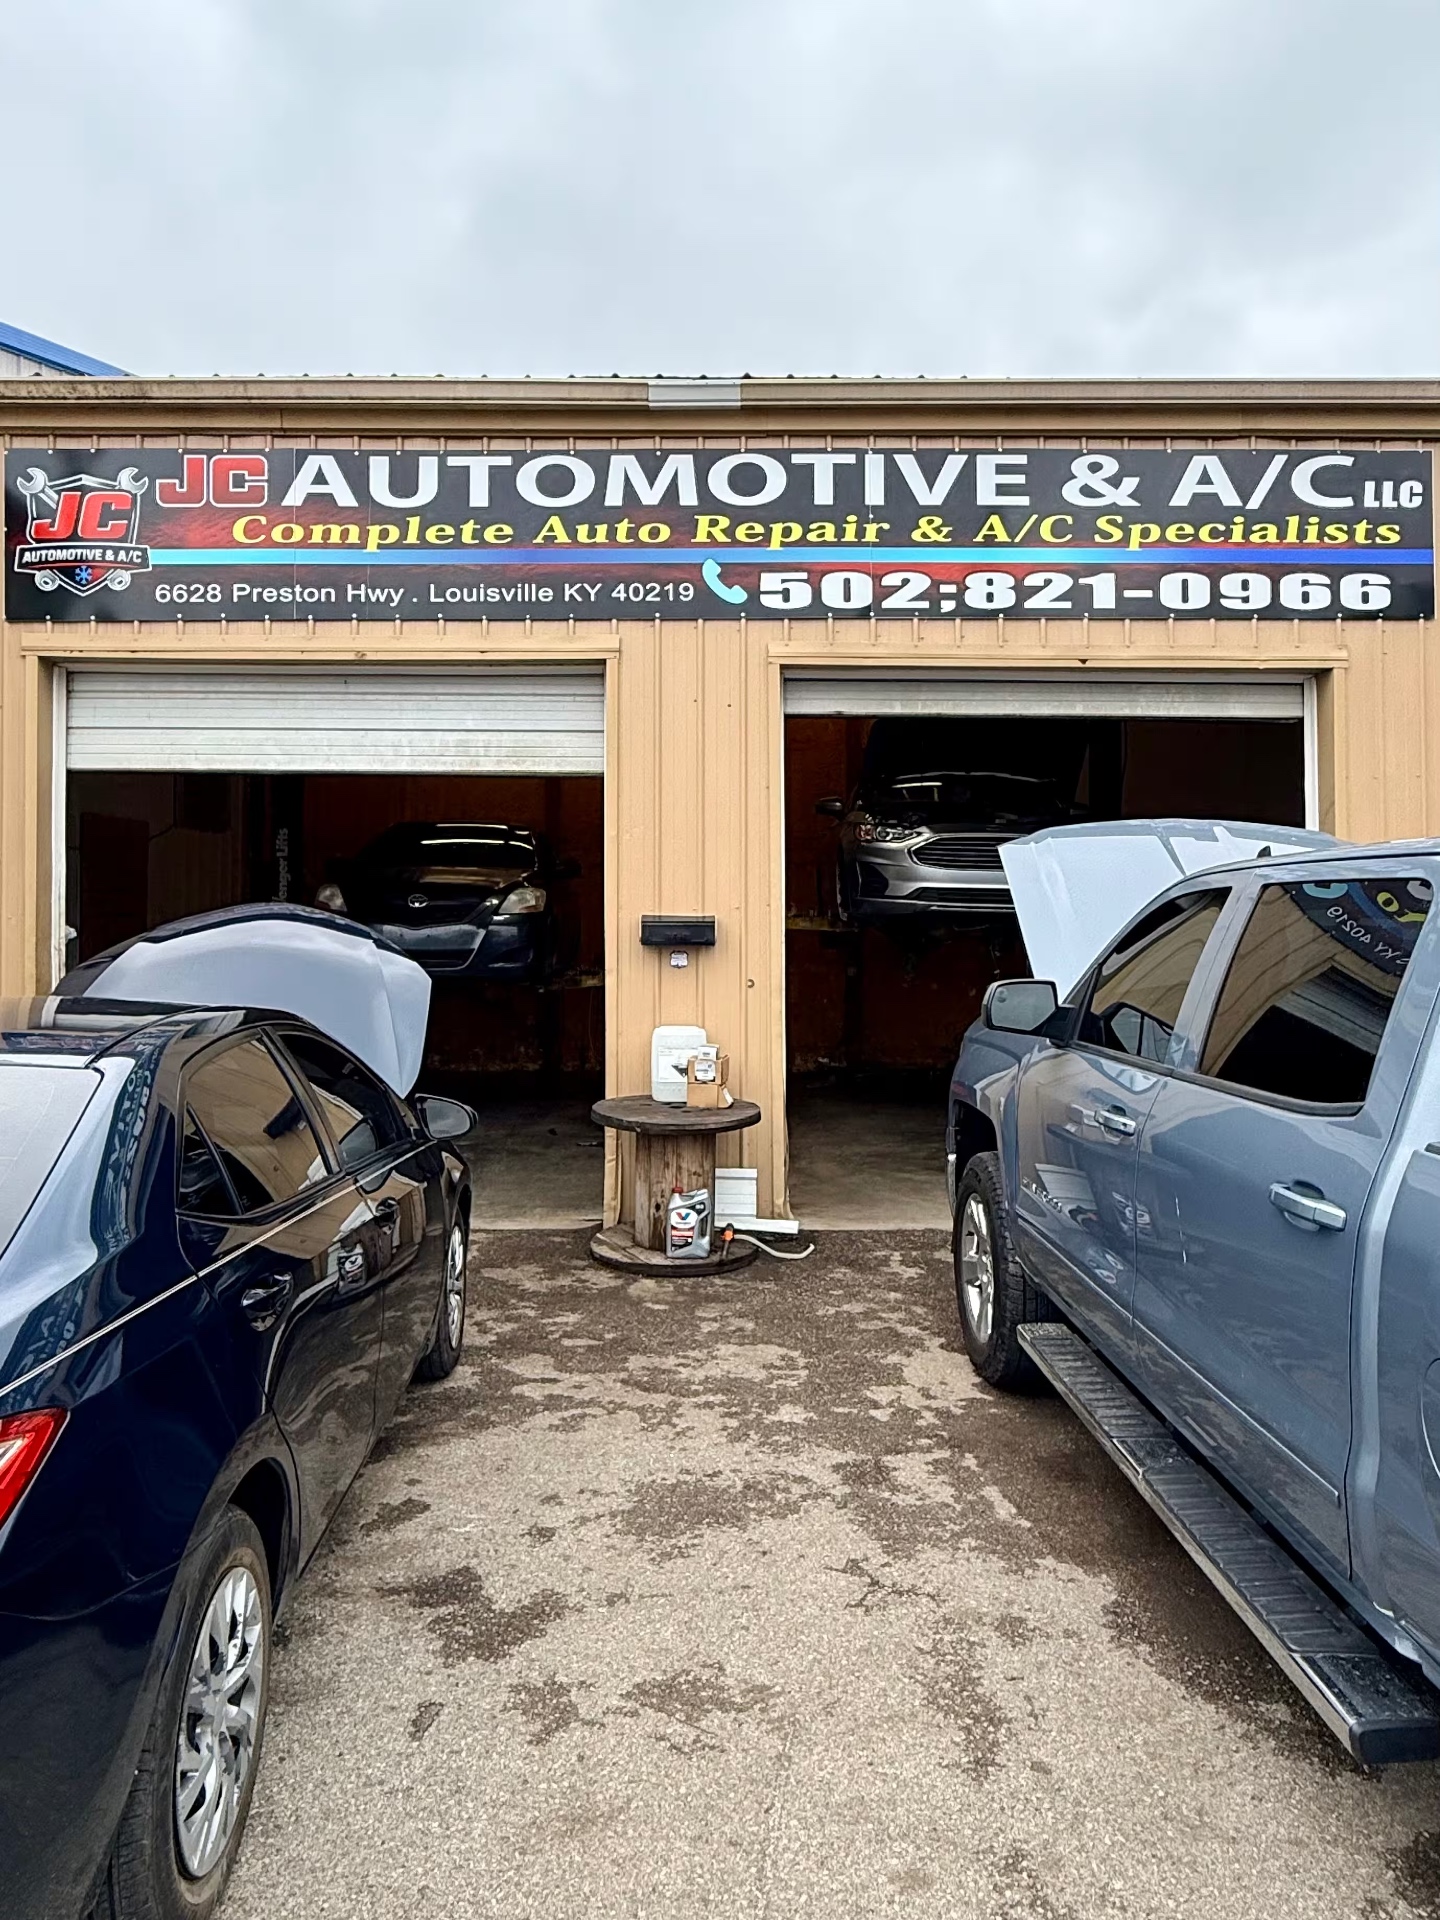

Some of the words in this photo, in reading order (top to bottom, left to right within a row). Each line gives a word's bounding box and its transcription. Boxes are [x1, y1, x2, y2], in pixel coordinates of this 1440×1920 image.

[156, 454, 268, 508] JC
[280, 454, 1030, 508] AUTOMOTIVE
[1061, 454, 1142, 507] &
[1168, 455, 1356, 509] A/C
[1363, 480, 1424, 508] LLC
[31, 491, 132, 539] JC
[232, 515, 514, 552] Complete
[533, 515, 671, 543] Auto
[691, 514, 890, 550] Repair
[911, 516, 953, 542] &
[973, 514, 1074, 543] A/C
[1094, 514, 1402, 550] Specialists
[22, 549, 103, 563] AUTOMOTIVE
[105, 550, 115, 562] &
[117, 550, 143, 563] A/C
[155, 584, 223, 603] 6628
[233, 583, 335, 603] Preston
[347, 584, 405, 607] Hwy
[430, 583, 554, 602] Louisville
[564, 584, 602, 602] KY
[611, 583, 695, 602] 40219
